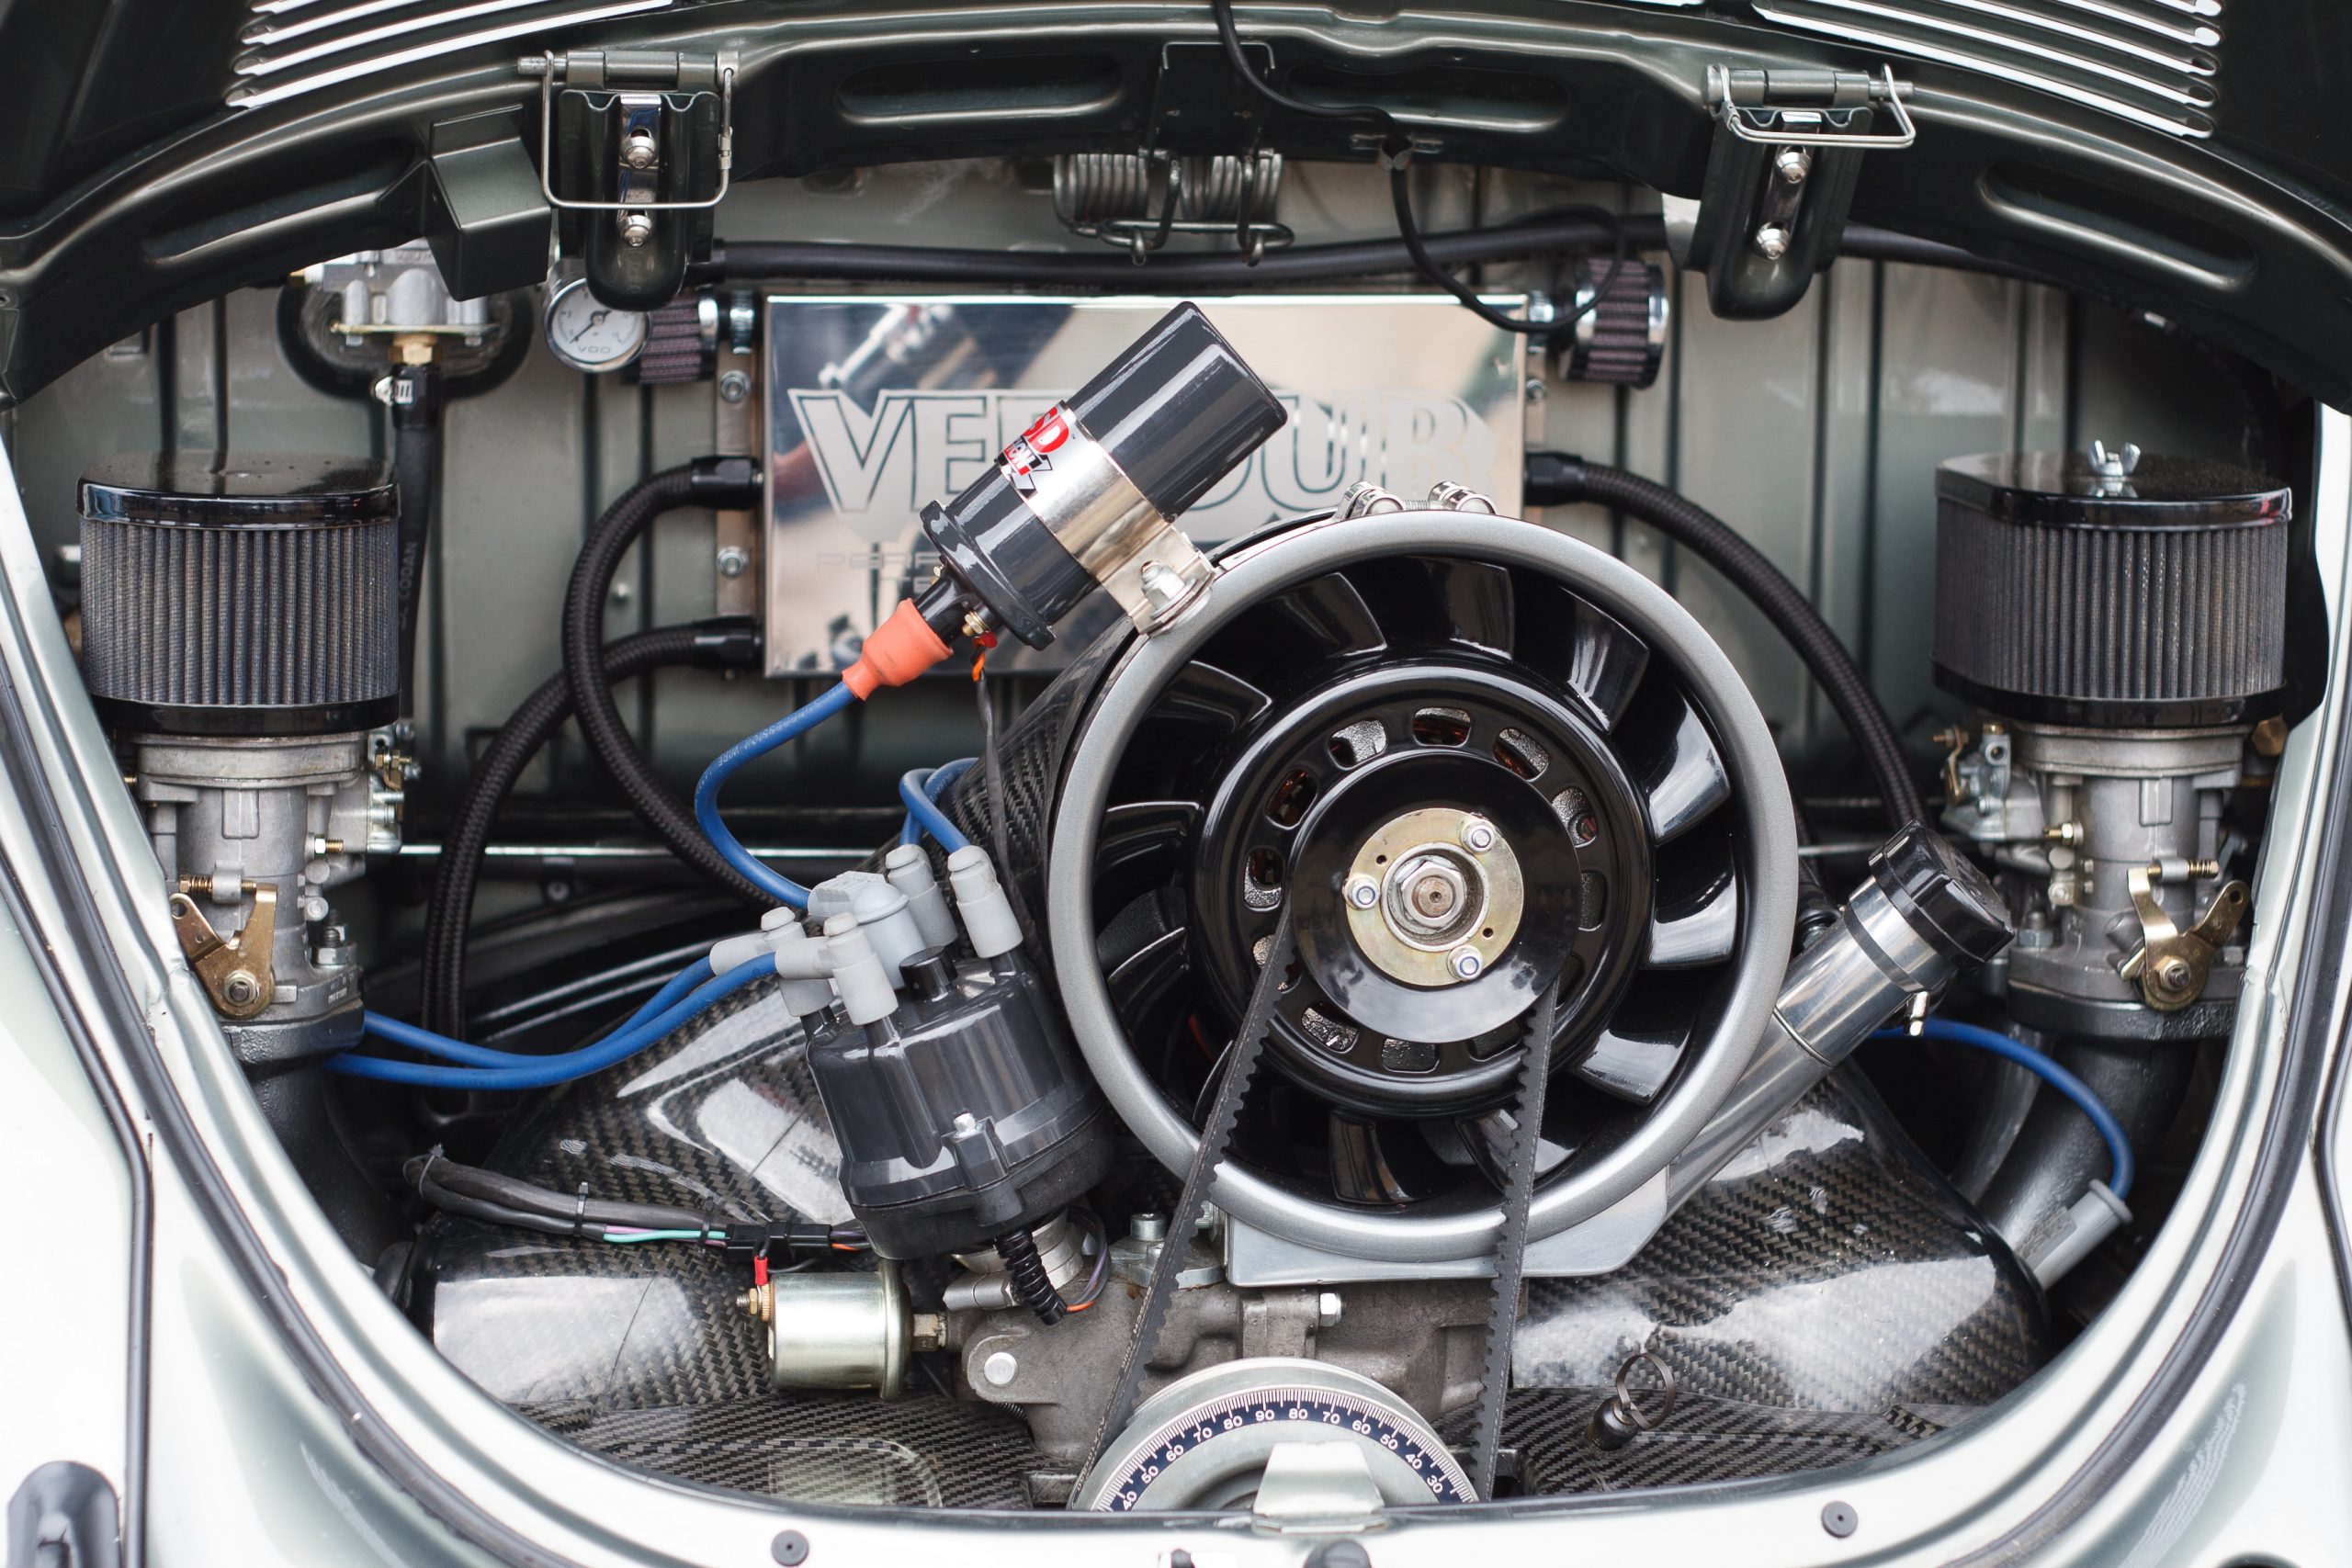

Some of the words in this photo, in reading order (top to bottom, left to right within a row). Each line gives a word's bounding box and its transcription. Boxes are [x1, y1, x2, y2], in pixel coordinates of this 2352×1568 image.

[577, 345, 611, 354] VDO
[1123, 1491, 1137, 1511] 40
[1141, 1465, 1159, 1484] 50
[1166, 1444, 1184, 1462] 60
[1193, 1427, 1213, 1443] 70
[1223, 1416, 1243, 1430] 80
[1255, 1409, 1275, 1421] 90
[1288, 1407, 1308, 1419] 80
[1322, 1411, 1340, 1425] 70
[1351, 1420, 1371, 1435] 60
[1380, 1433, 1398, 1450] 50
[1405, 1453, 1423, 1470] 40
[1426, 1474, 1443, 1495] 30
